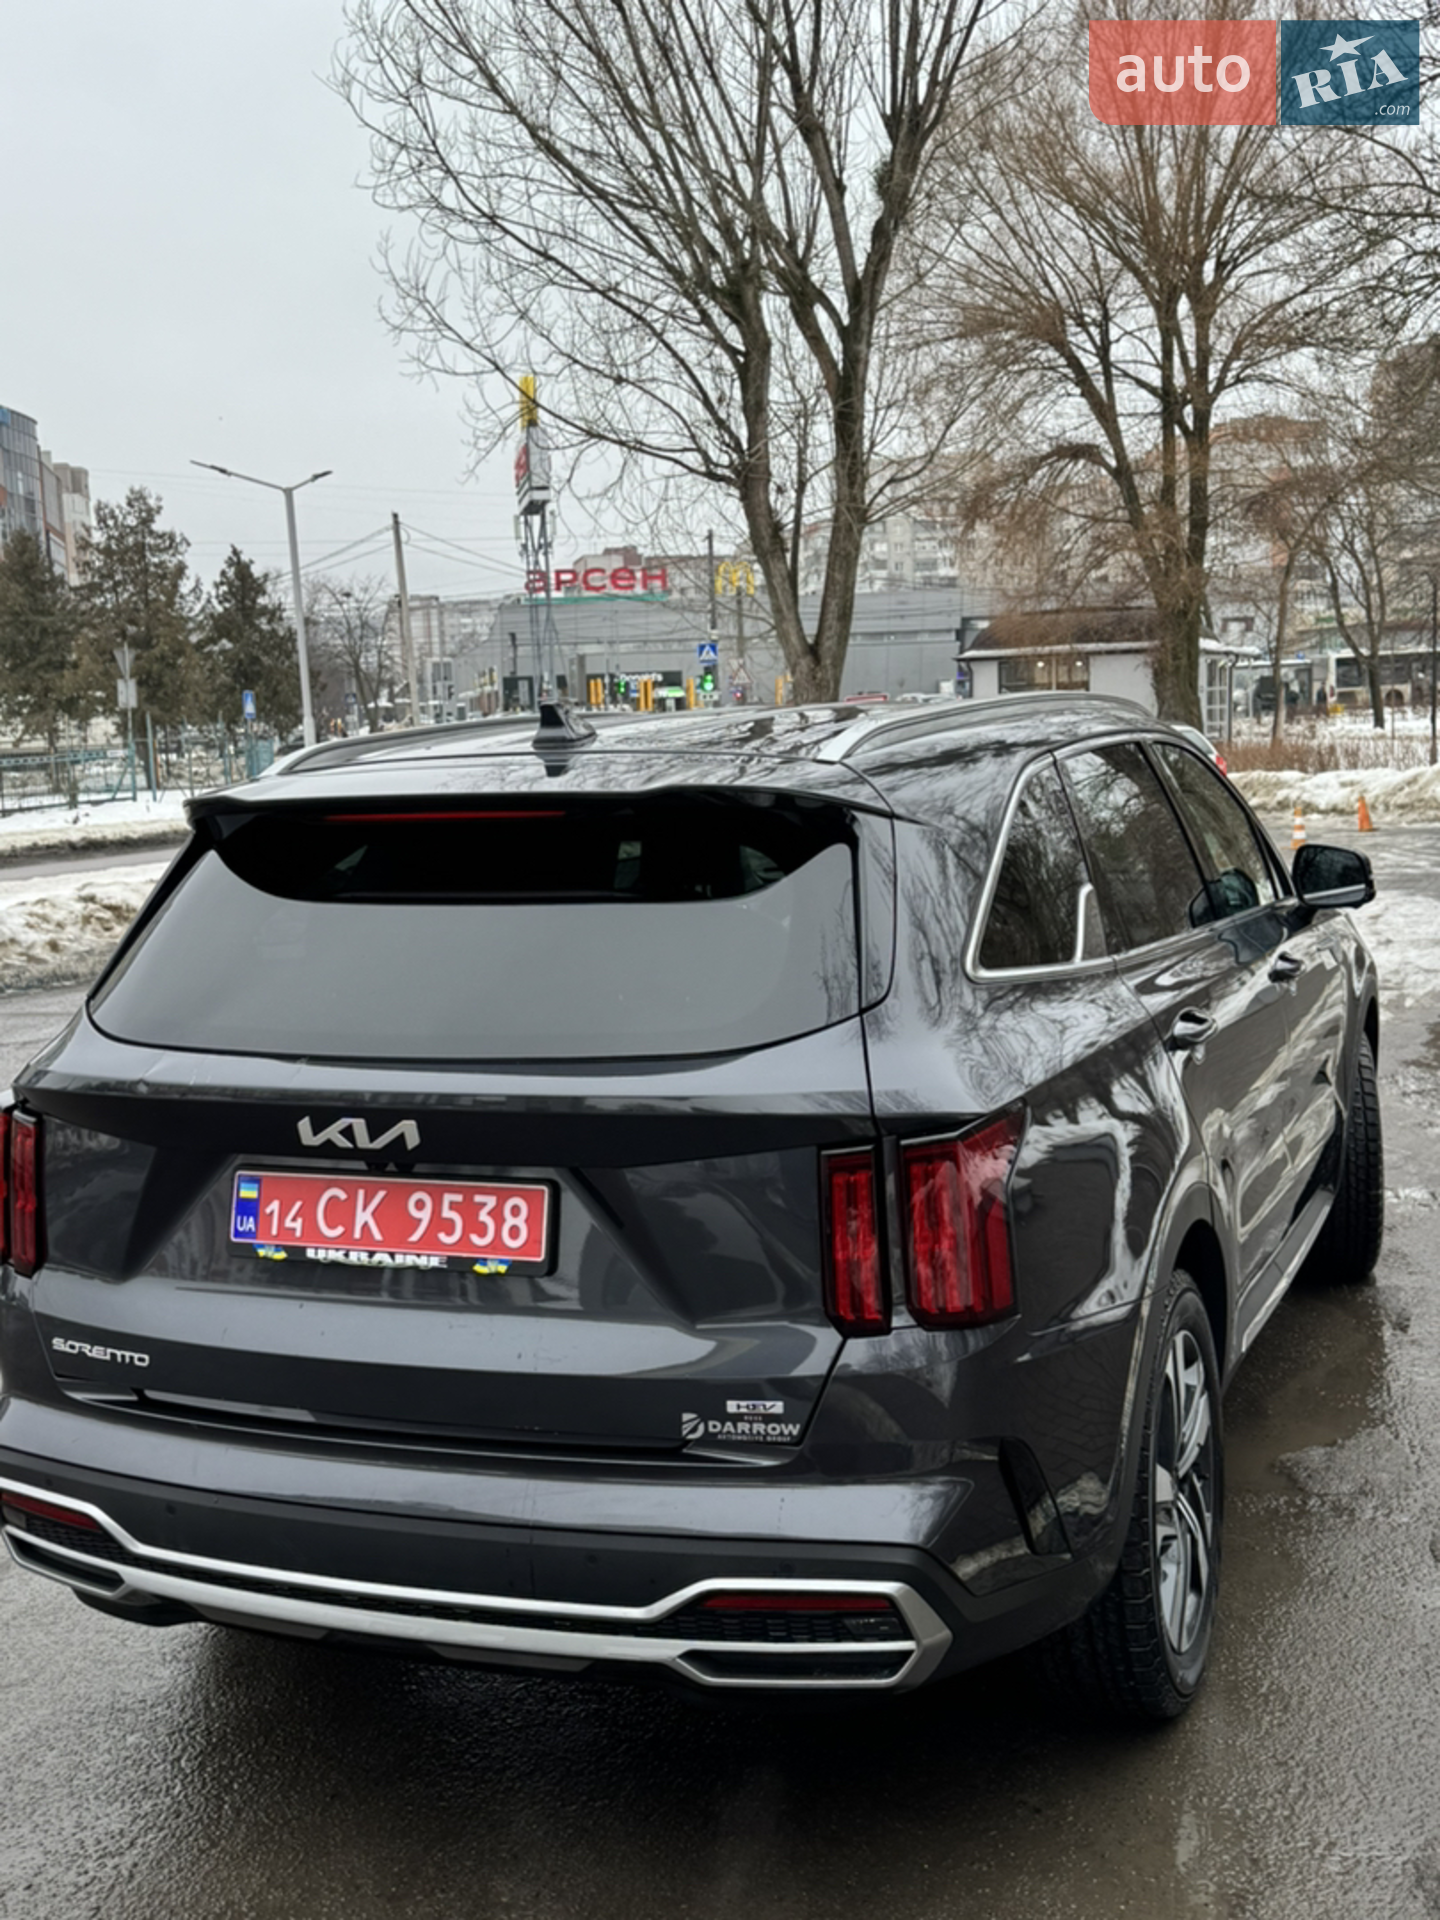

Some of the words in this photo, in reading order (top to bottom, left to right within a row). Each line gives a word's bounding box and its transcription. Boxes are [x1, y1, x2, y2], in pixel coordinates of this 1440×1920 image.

[297, 1115, 421, 1151] KIA
[236, 1215, 256, 1233] UA
[264, 1199, 303, 1238] 14
[315, 1186, 388, 1243] CK
[407, 1190, 529, 1250] 9538
[305, 1246, 449, 1269] UKRAINE
[51, 1336, 150, 1368] SORENTO
[707, 1419, 801, 1437] DARROW
